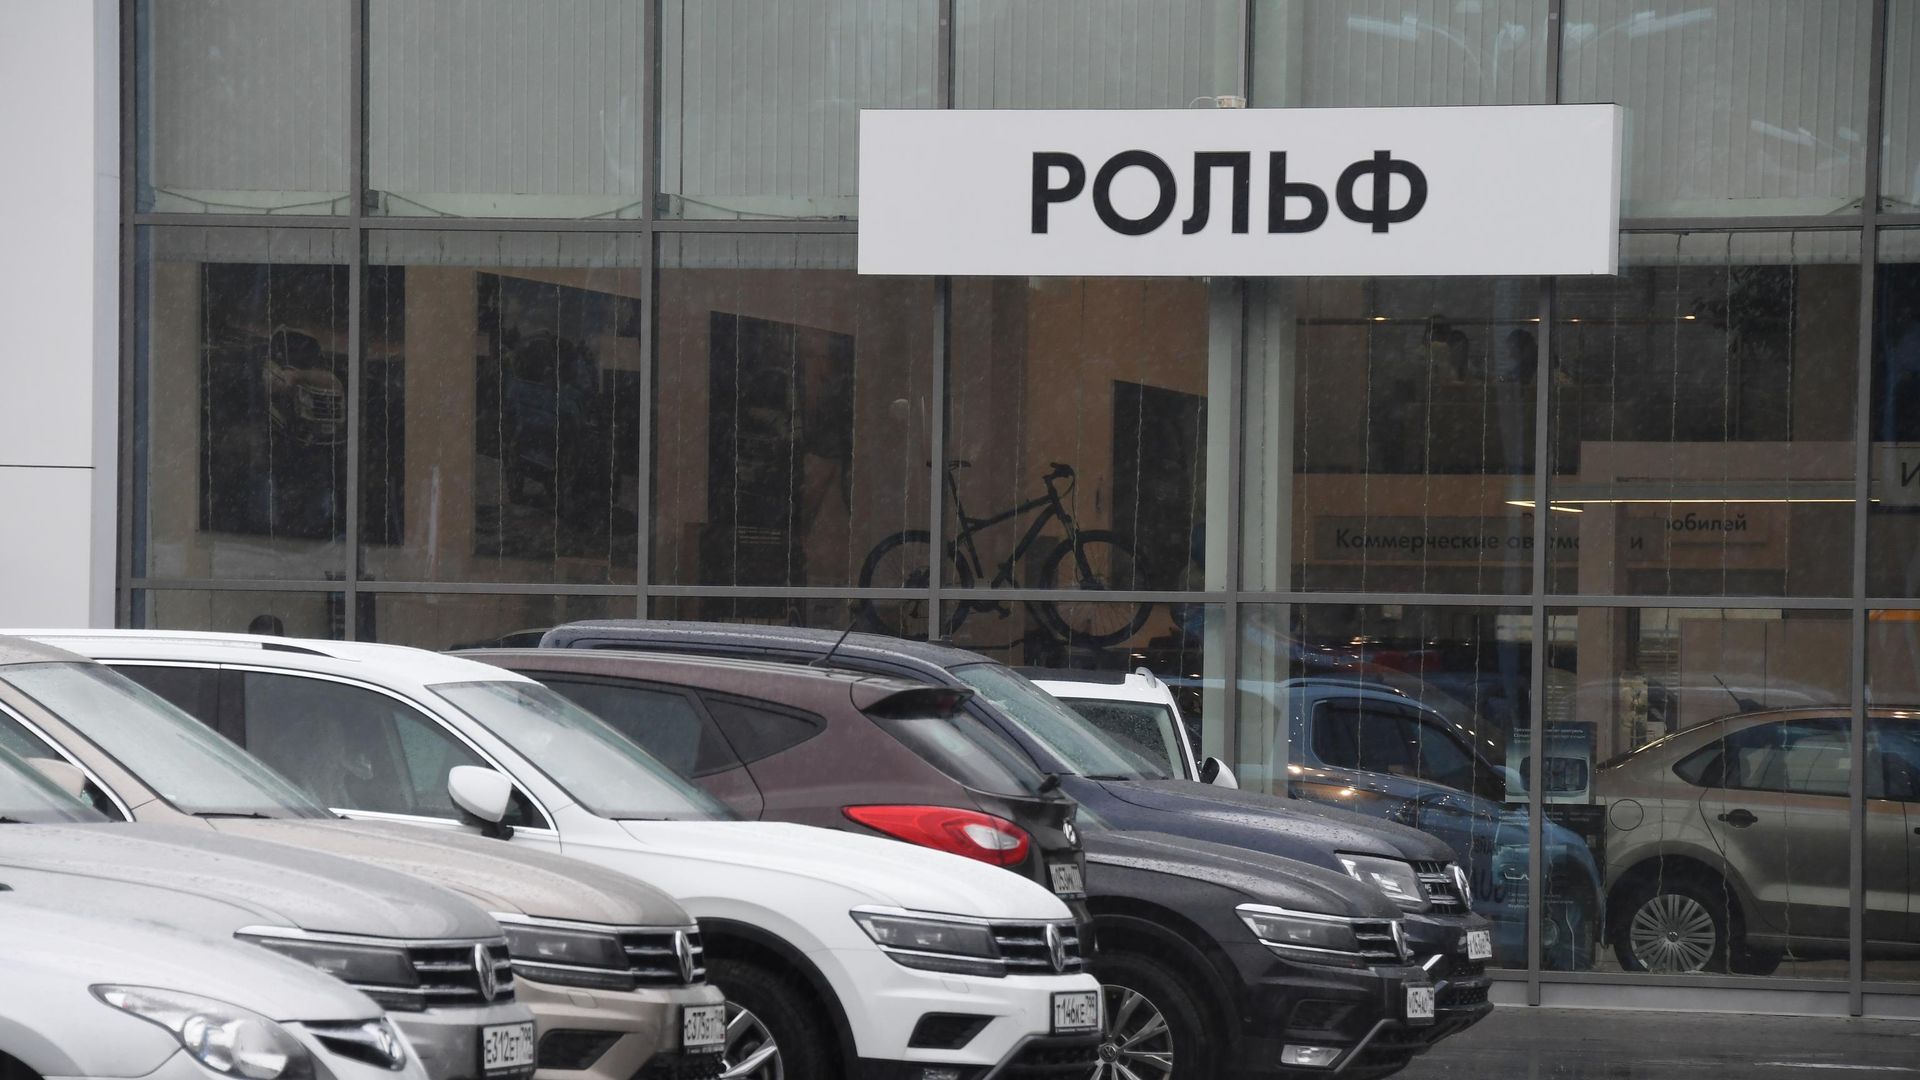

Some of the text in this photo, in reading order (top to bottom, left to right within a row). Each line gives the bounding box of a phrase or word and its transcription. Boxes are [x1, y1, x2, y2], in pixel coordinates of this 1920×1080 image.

[1031, 149, 1428, 236] РОЛЬФ
[1665, 512, 1747, 531] обилей
[1335, 528, 1500, 553] Коммерческие
